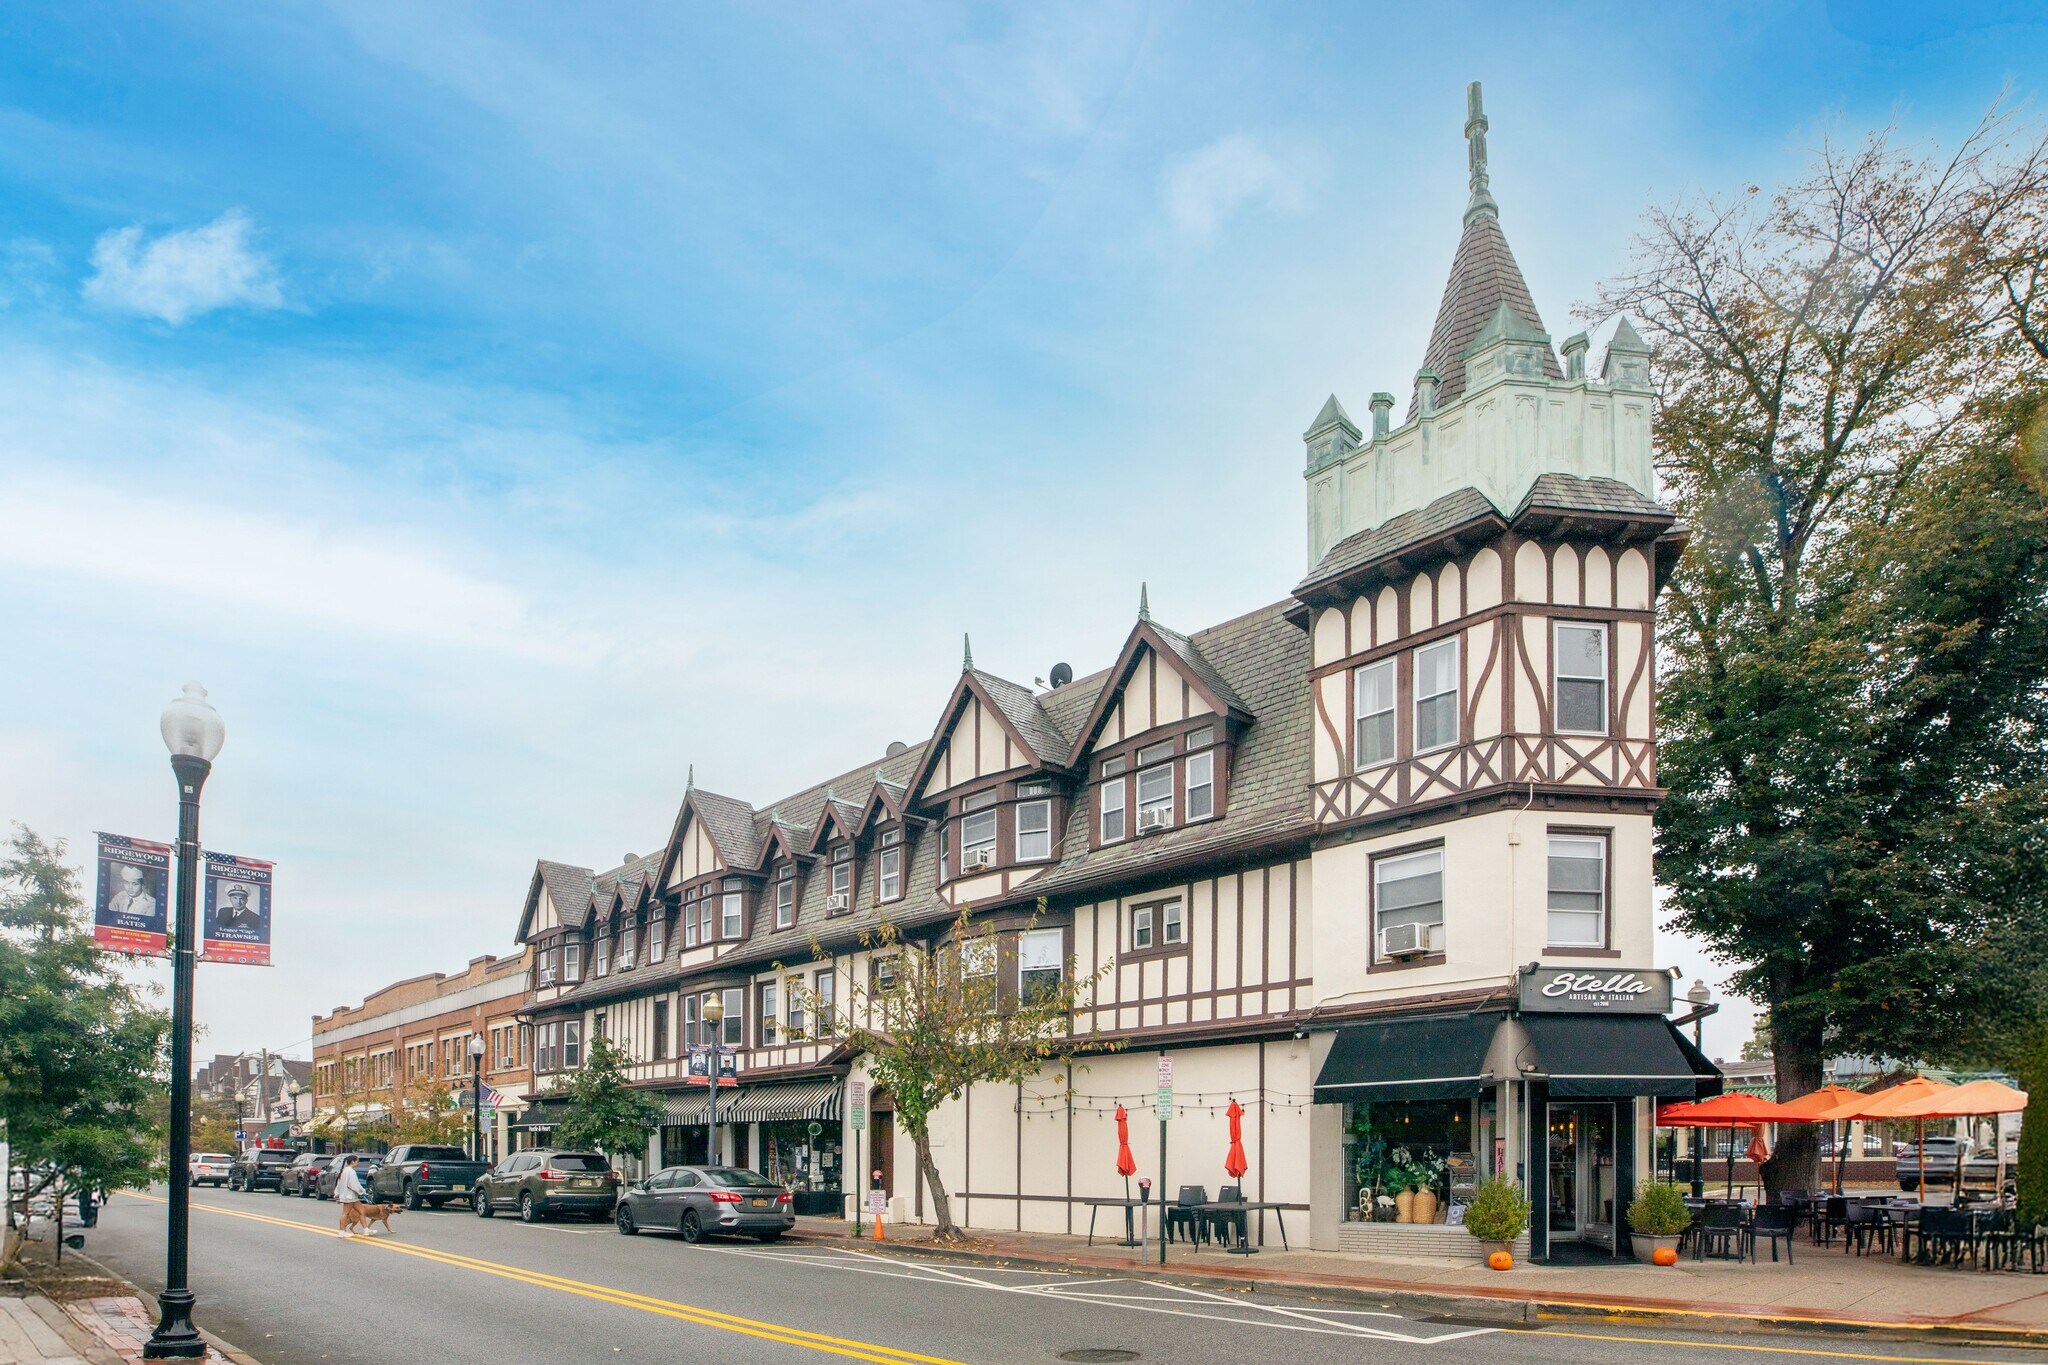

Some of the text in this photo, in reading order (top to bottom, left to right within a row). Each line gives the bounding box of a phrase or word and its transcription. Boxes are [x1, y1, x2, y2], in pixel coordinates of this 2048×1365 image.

[104, 846, 165, 863] RIDGEWOOD
[121, 855, 147, 864] HONORS
[211, 864, 267, 878] RIDGEWOOD
[227, 872, 251, 880] HONORS
[117, 919, 146, 928] BATES
[215, 932, 260, 941] STRAWSER
[1541, 973, 1652, 997] Stella
